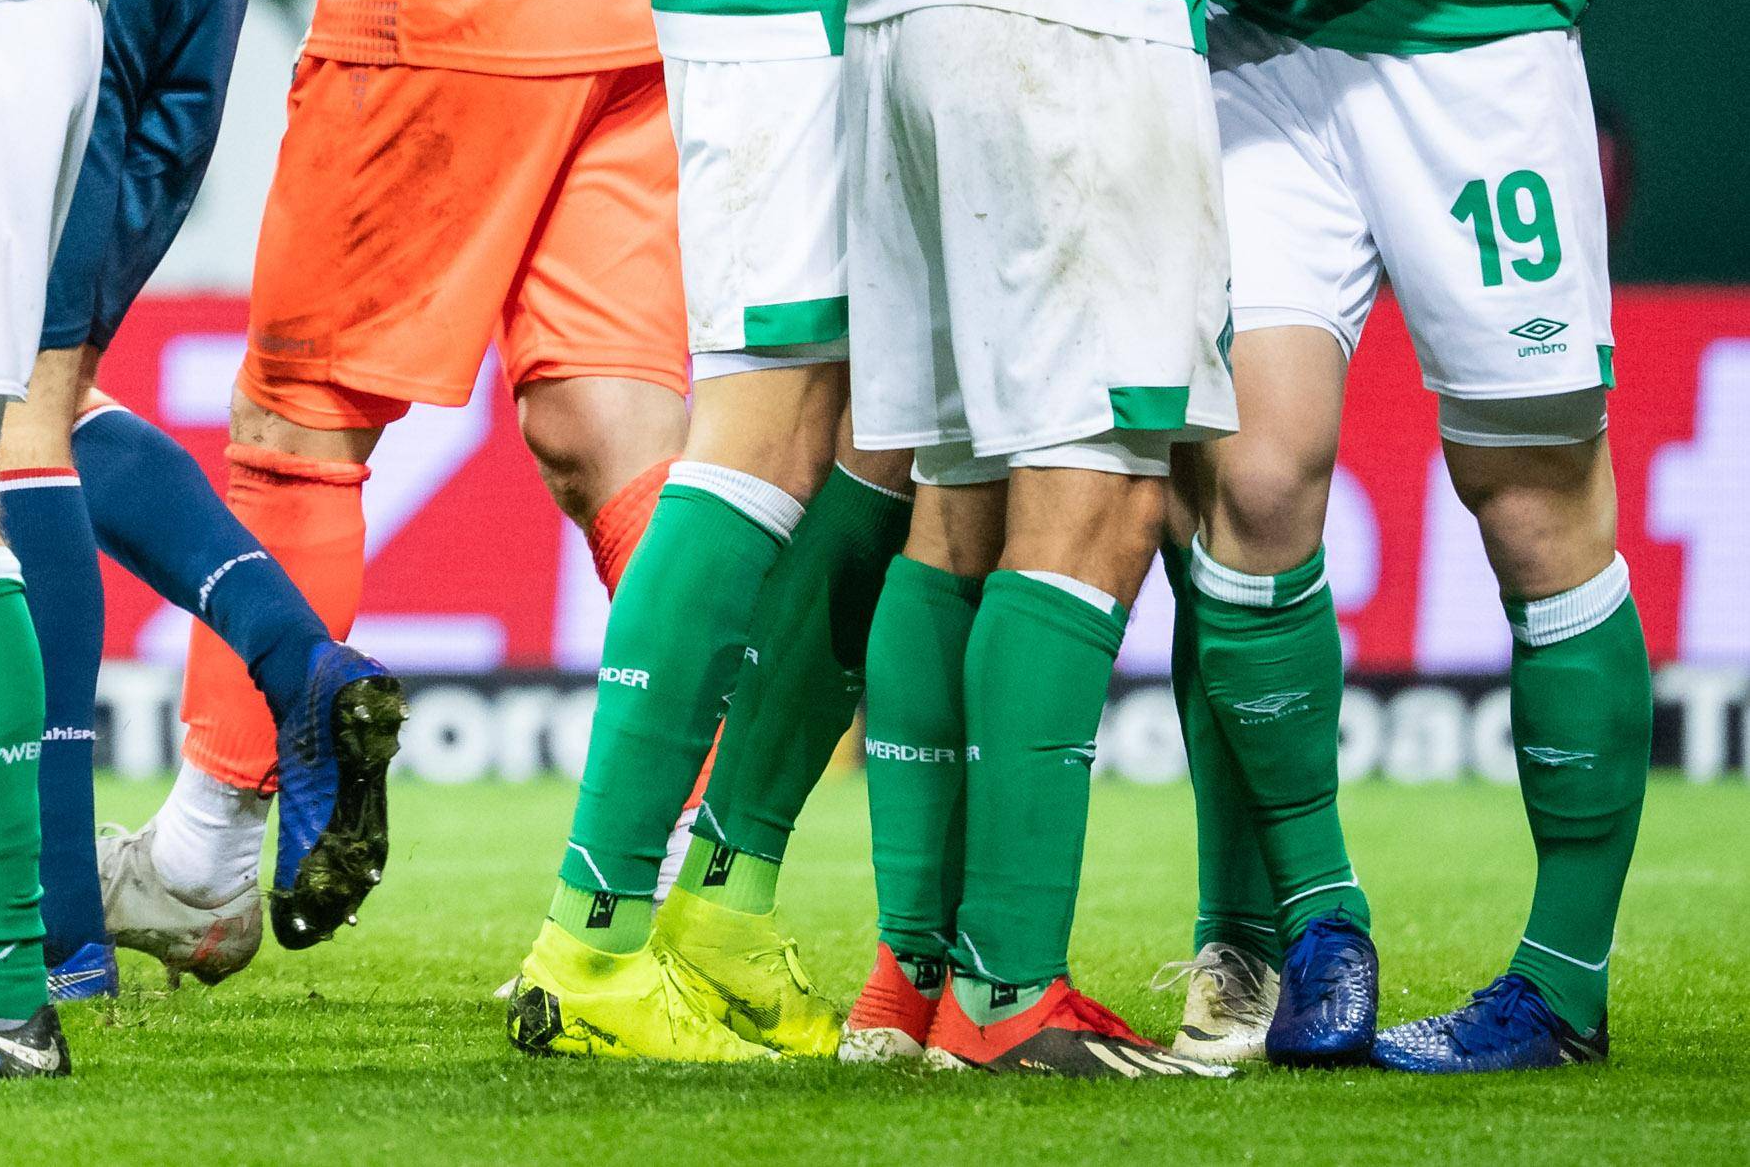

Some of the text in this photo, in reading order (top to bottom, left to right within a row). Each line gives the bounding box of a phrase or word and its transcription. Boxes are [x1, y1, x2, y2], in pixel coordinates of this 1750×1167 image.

[1450, 169, 1562, 287] 19
[1517, 343, 1567, 358] umbro
[866, 736, 955, 763] WERDER
